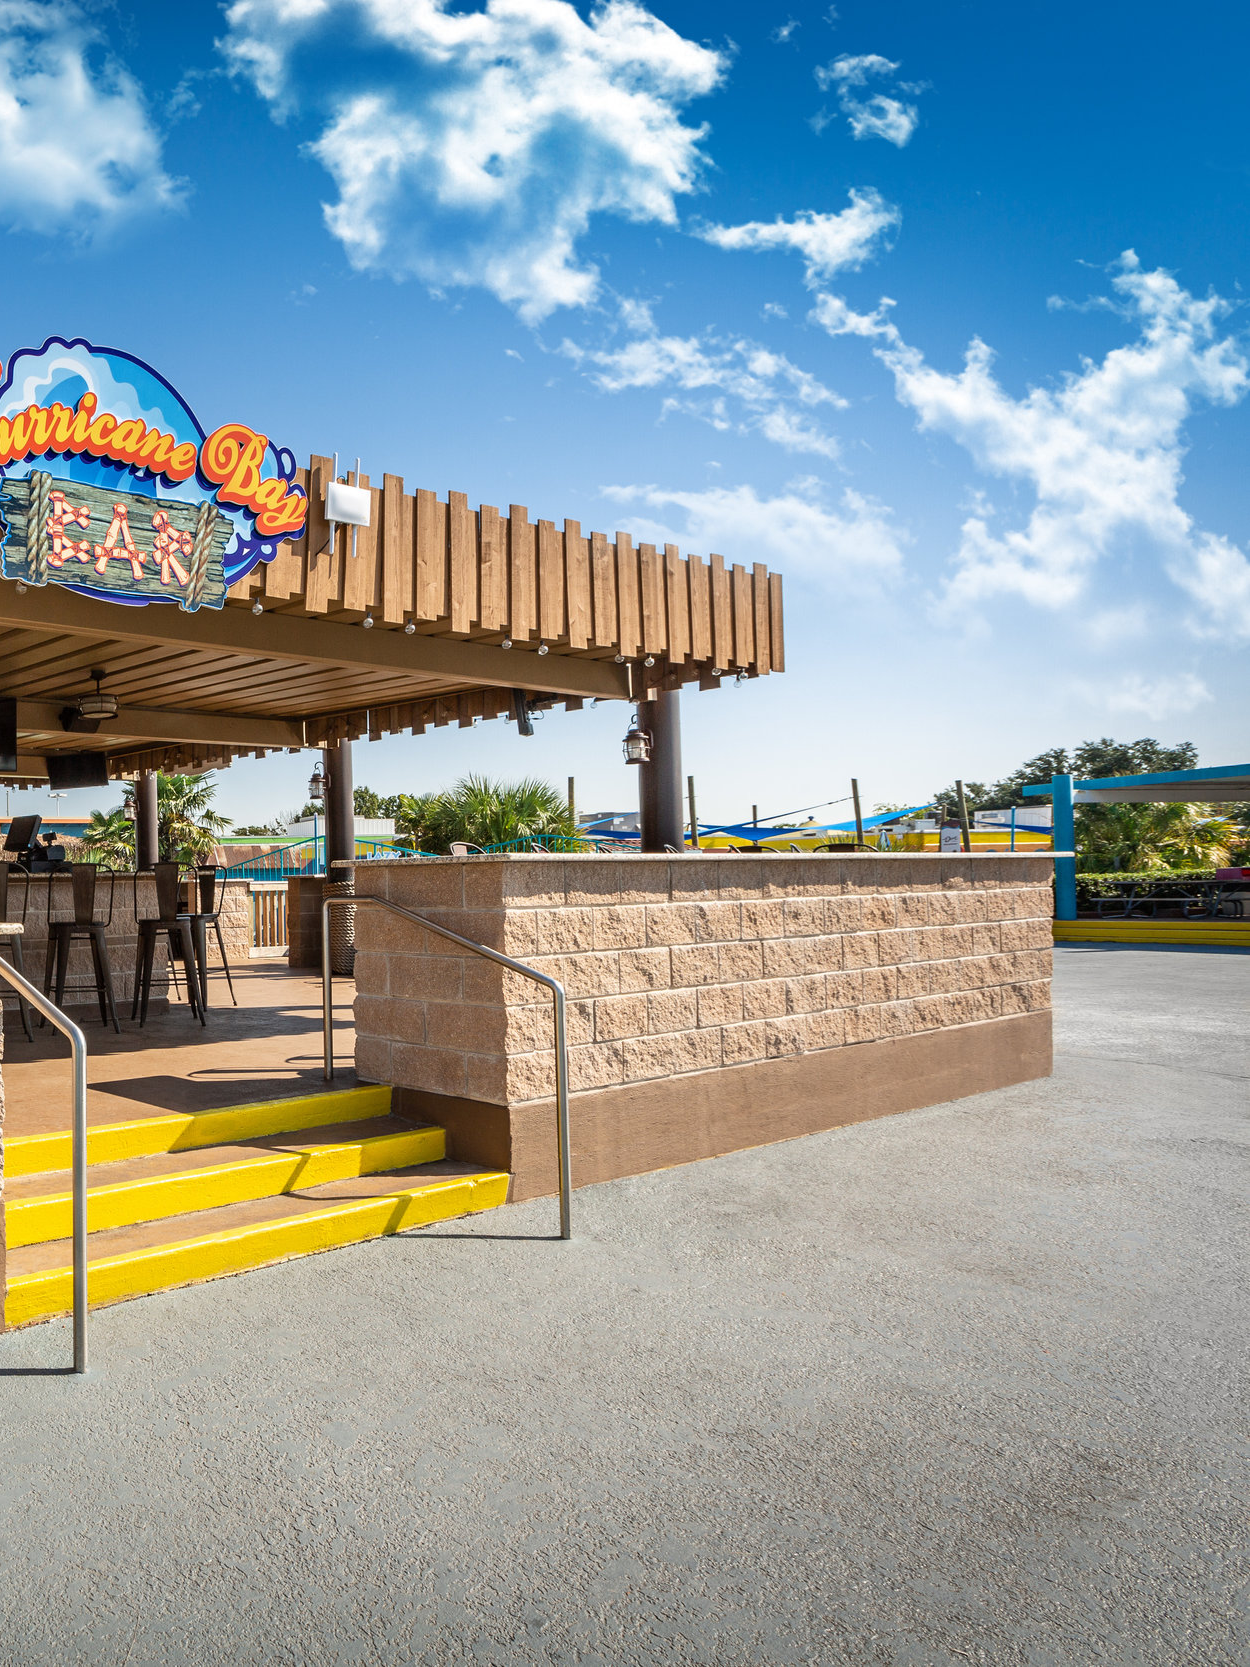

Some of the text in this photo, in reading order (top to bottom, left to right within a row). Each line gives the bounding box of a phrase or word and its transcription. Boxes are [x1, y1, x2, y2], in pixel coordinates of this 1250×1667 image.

[201, 422, 308, 536] Bay
[46, 490, 193, 587] BAR
[367, 850, 401, 860] LAZY
